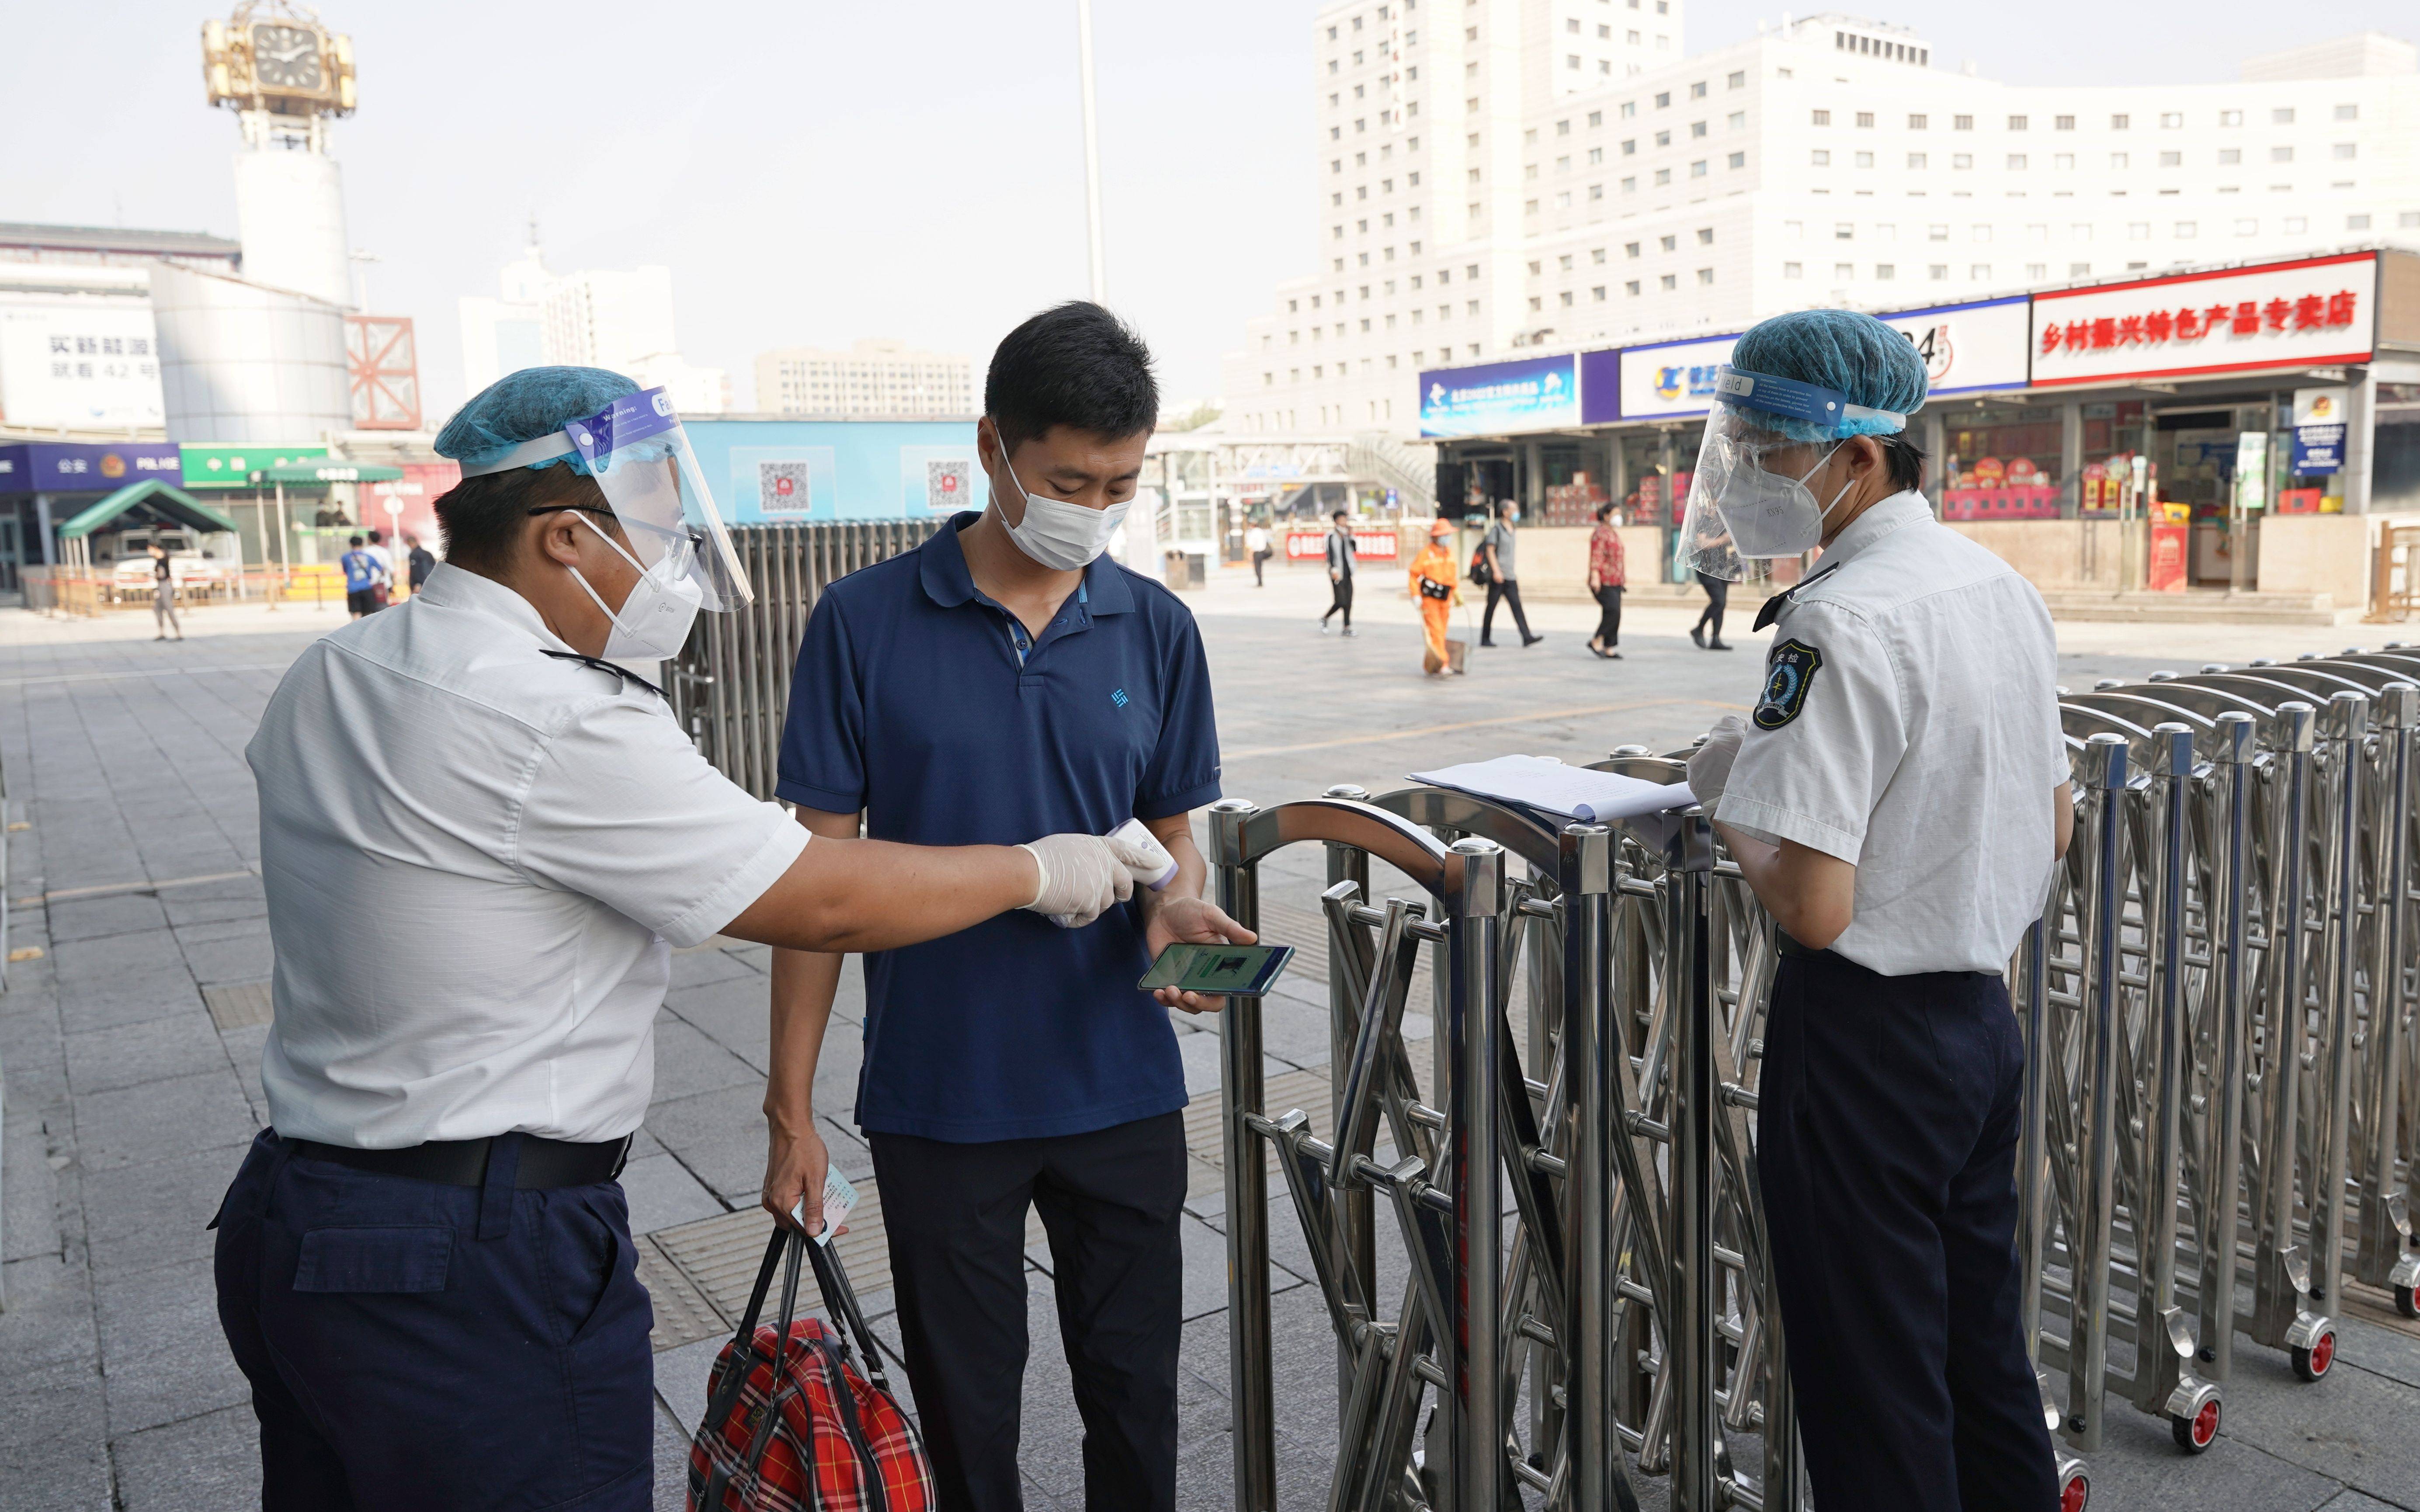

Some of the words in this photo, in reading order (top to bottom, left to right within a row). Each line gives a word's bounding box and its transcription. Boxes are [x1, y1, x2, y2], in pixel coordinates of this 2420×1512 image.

[2042, 290, 2356, 354] 乡村振兴特色产品专卖店
[603, 406, 637, 421] Warning:
[136, 457, 180, 470] POLICE
[1776, 653, 1799, 663] 安检
